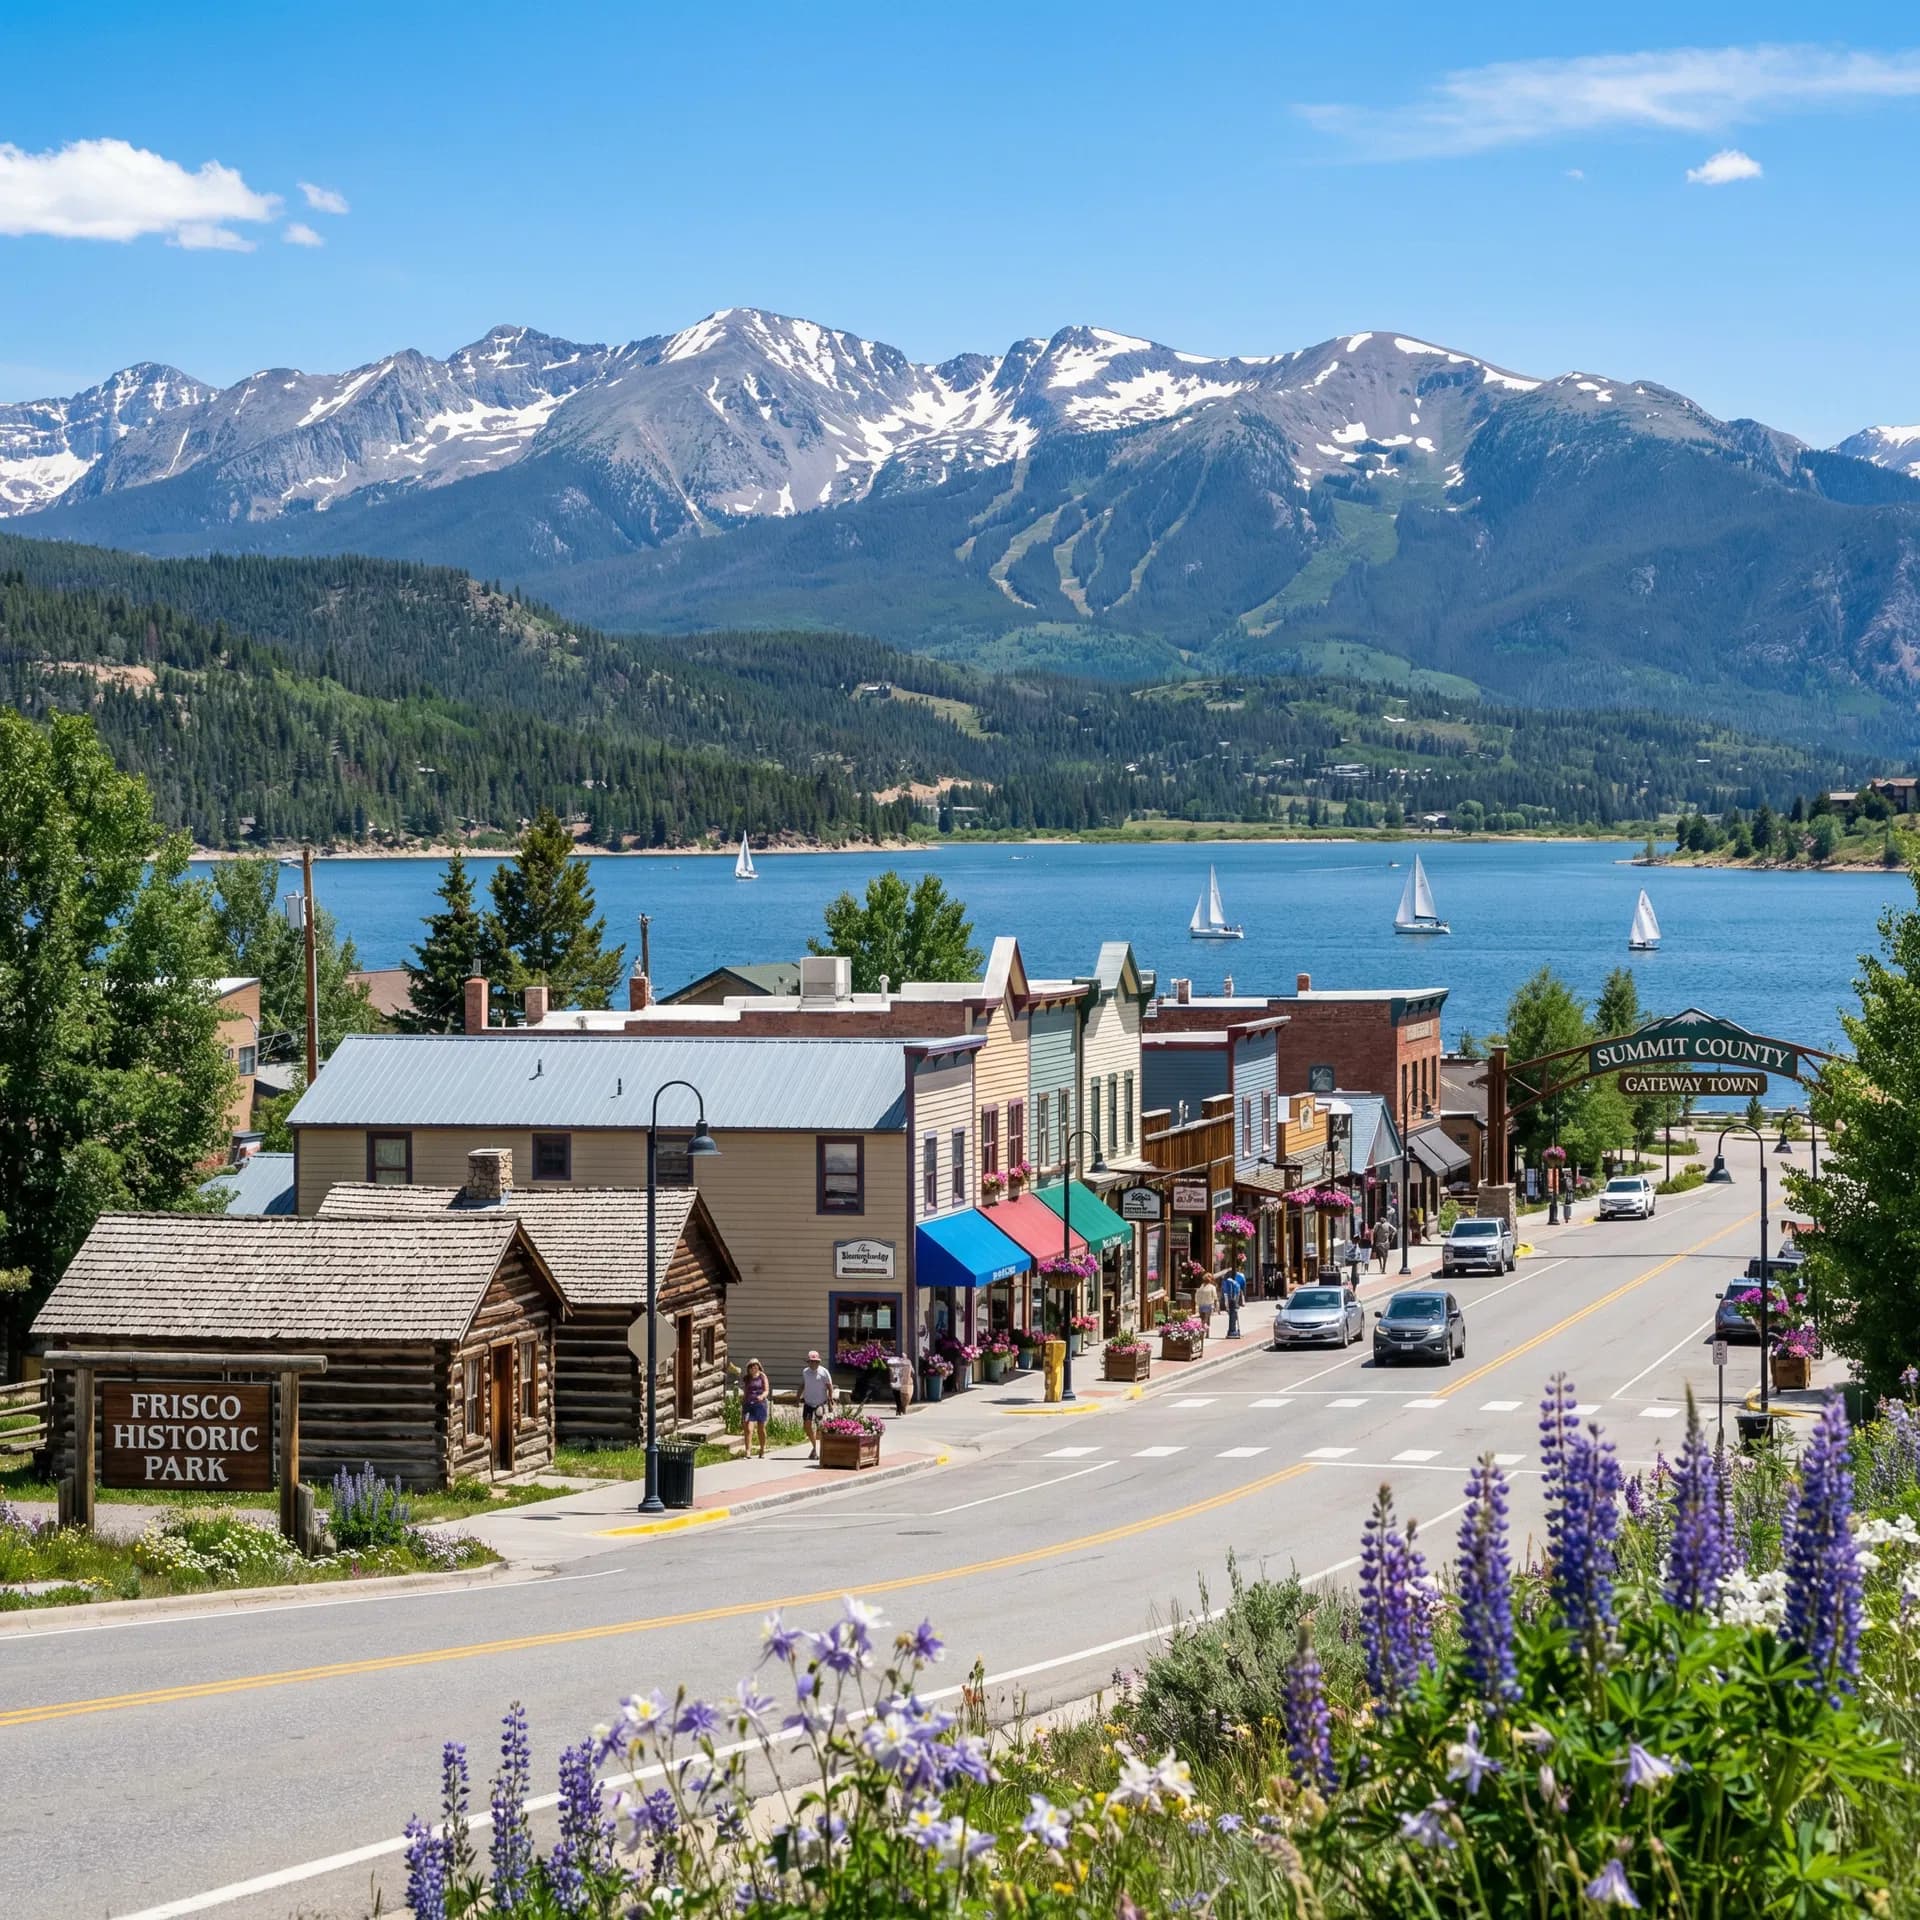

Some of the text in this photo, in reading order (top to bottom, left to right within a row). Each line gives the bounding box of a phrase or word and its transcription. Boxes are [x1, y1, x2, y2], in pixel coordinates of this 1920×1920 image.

[1596, 1038, 1789, 1068] SUMMIT COUNTY
[1625, 1077, 1759, 1093] GATEWAY TOWN
[130, 1393, 241, 1420] FRISCO
[113, 1424, 259, 1451] HISTORIC
[144, 1455, 229, 1482] PARK
